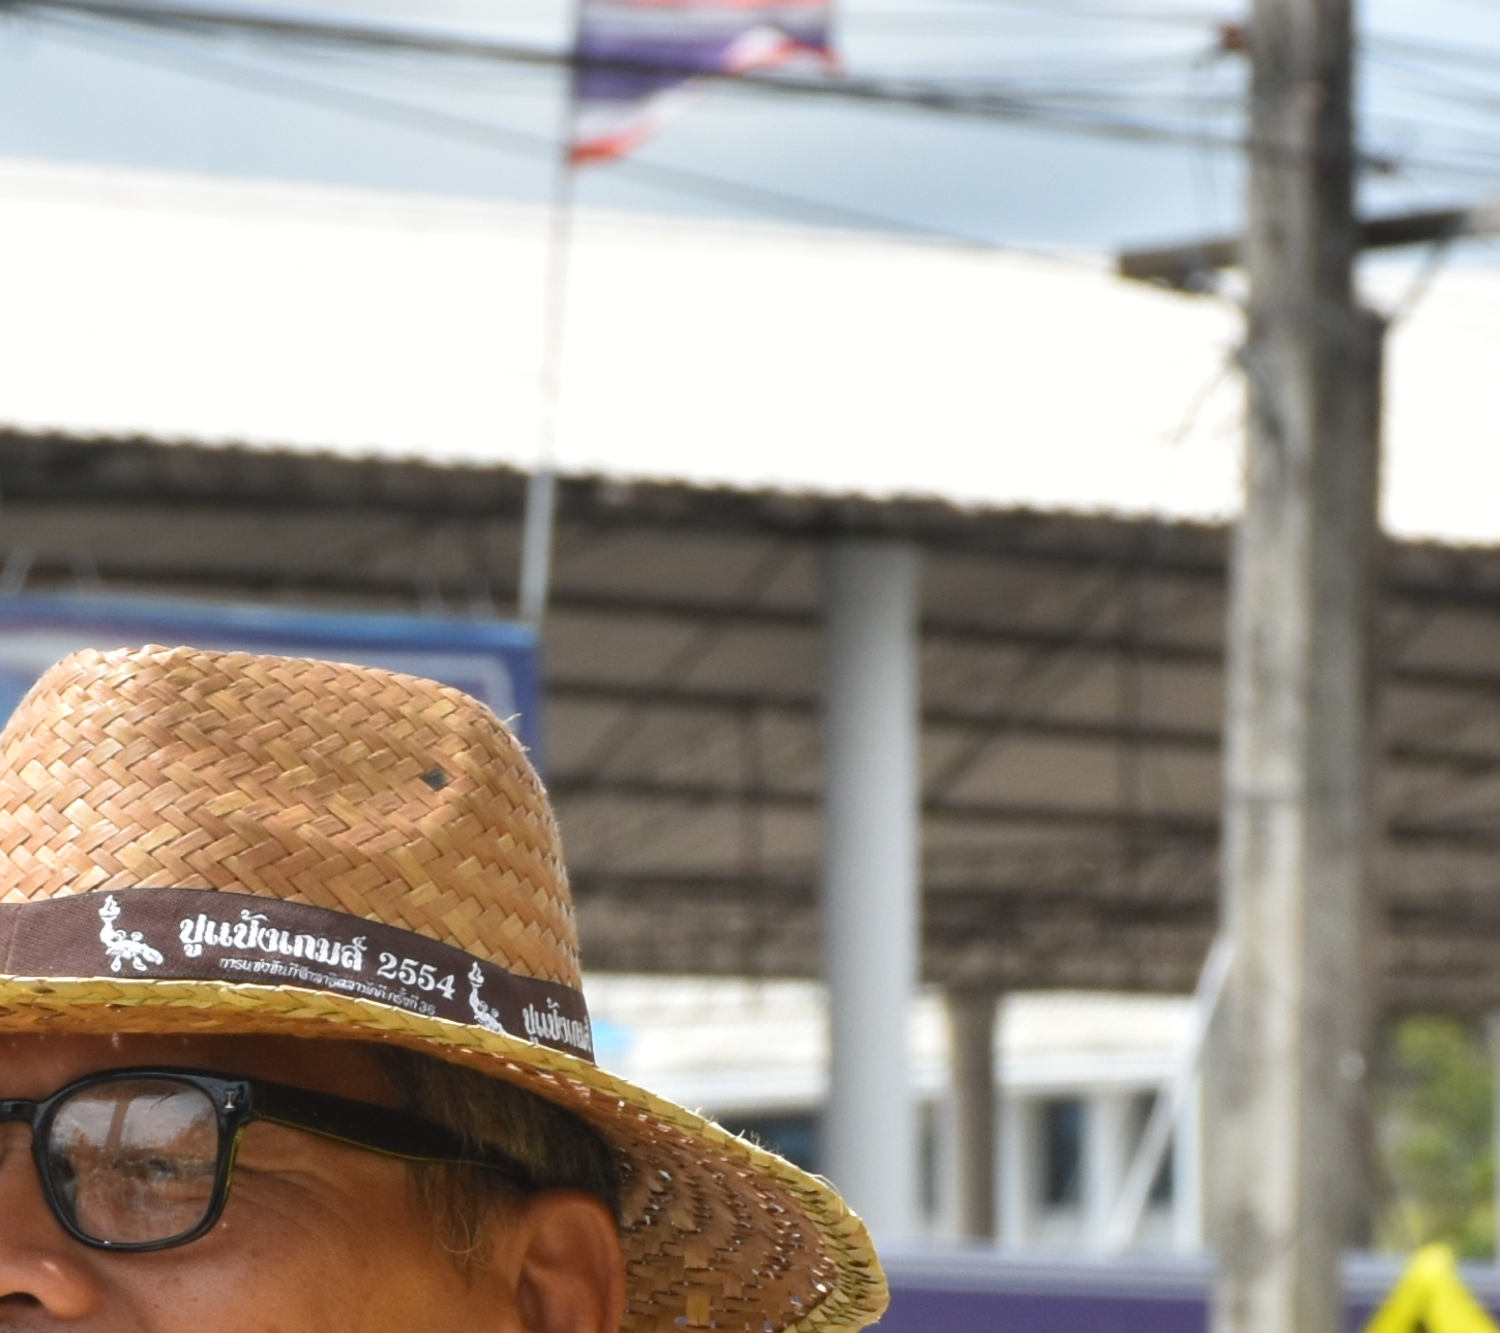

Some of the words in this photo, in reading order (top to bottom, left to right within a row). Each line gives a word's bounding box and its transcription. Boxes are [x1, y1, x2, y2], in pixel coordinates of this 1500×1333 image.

[179, 909, 367, 971] ปูแป้งเกมส์
[376, 952, 457, 1000] 2554
[419, 1001, 436, 1015] 36
